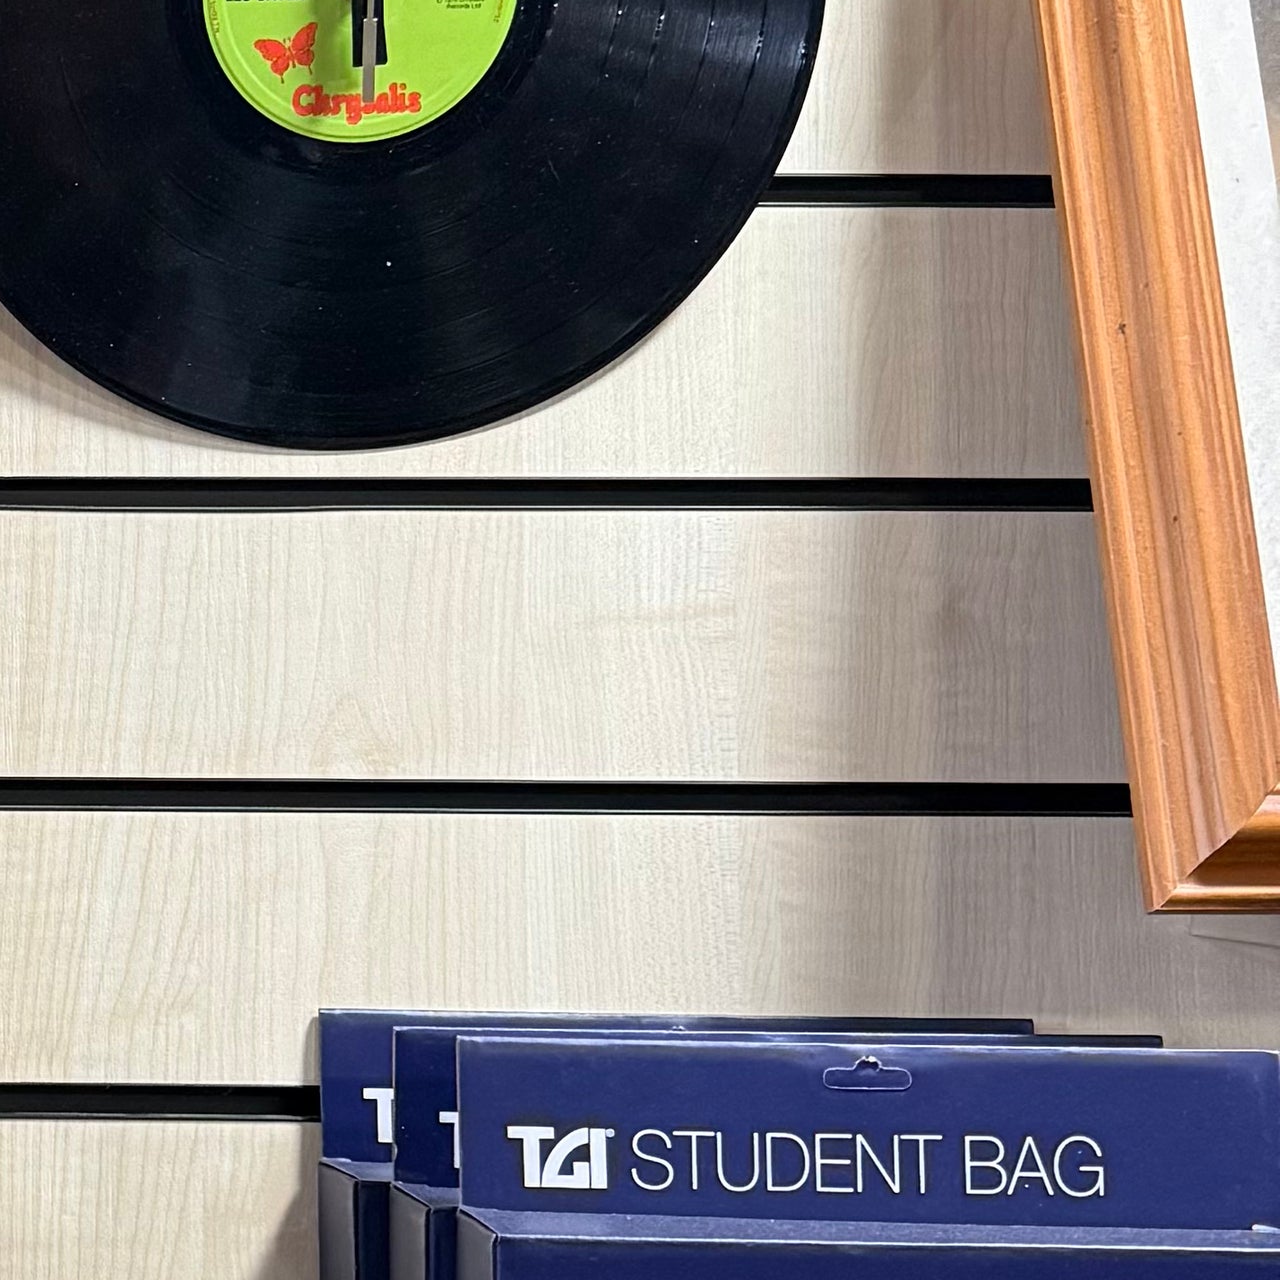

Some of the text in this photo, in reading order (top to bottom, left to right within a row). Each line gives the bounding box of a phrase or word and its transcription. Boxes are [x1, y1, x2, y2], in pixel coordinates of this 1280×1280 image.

[507, 1125, 609, 1190] TGI
[631, 1128, 943, 1195] STUDENT
[964, 1134, 1105, 1198] BAG
